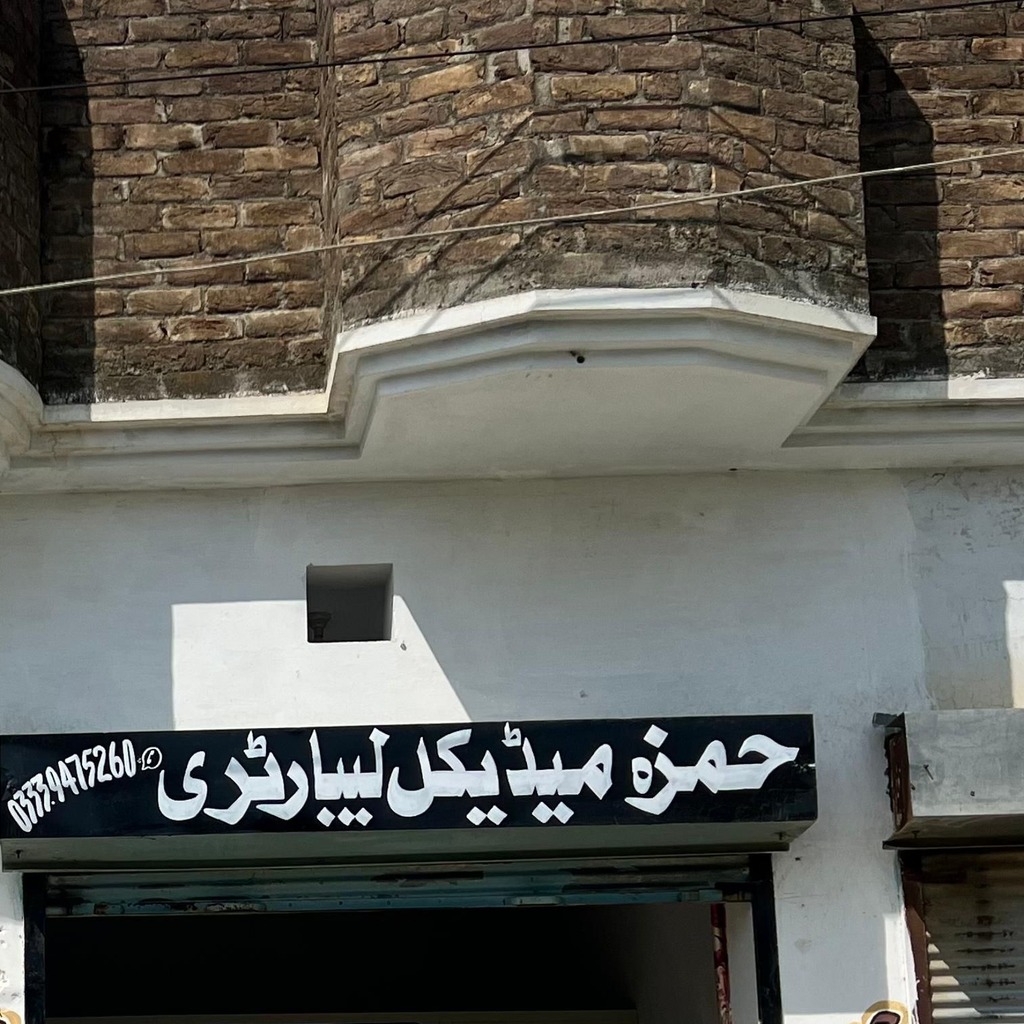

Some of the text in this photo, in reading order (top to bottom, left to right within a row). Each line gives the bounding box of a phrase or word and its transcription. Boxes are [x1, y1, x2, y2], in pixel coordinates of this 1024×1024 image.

[157, 721, 800, 827] حمزہ میڈیکل لیبارٹری
